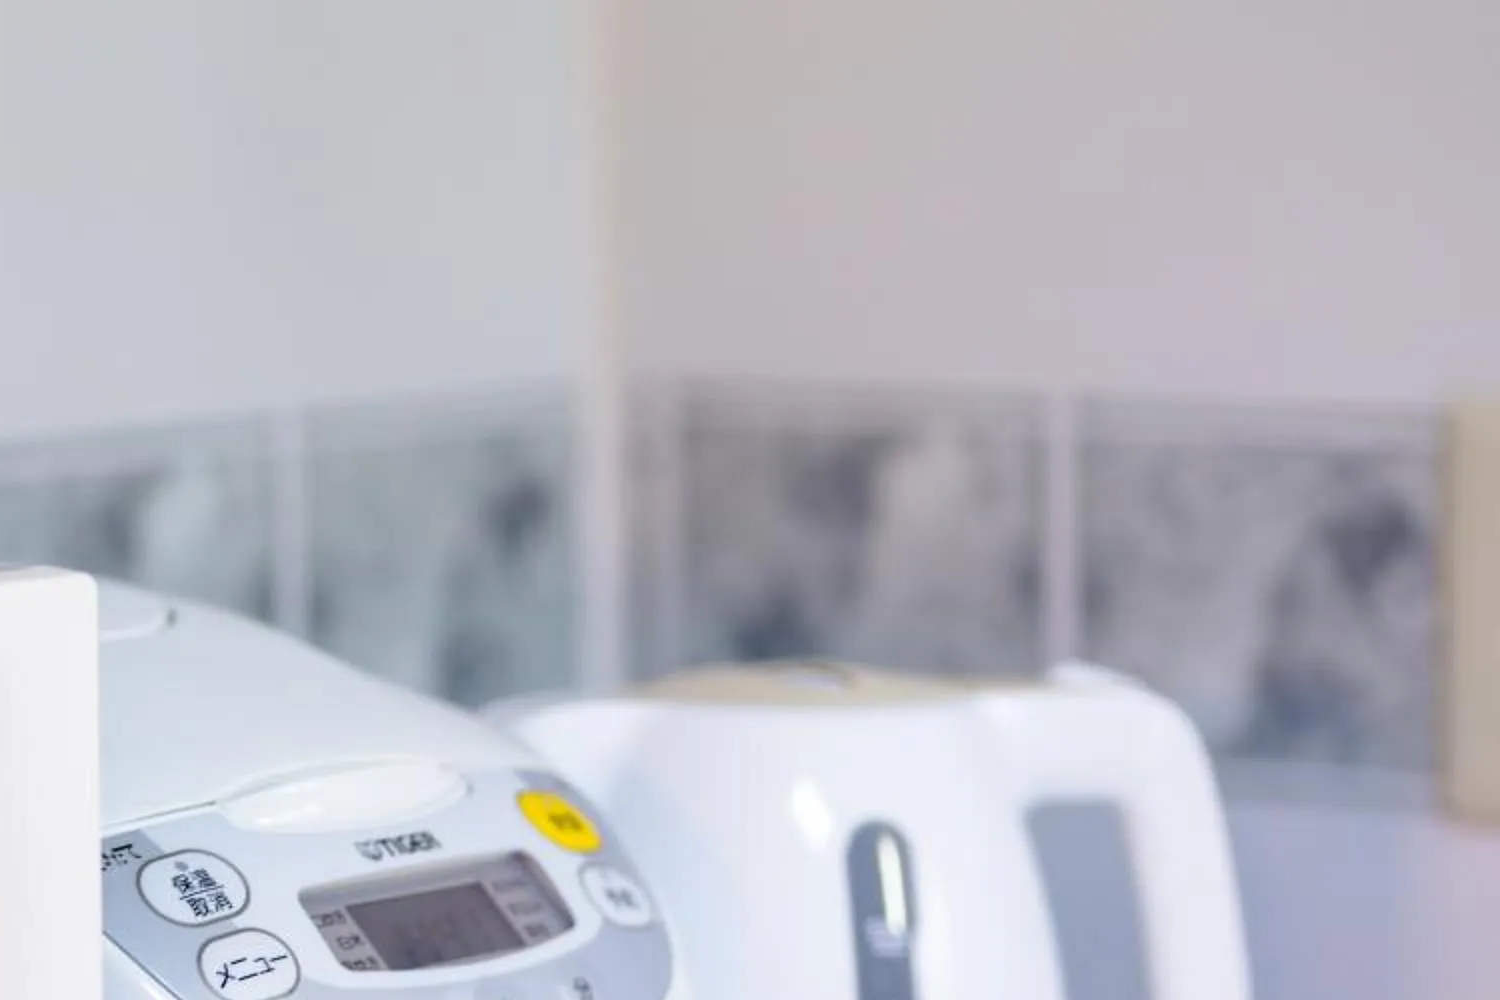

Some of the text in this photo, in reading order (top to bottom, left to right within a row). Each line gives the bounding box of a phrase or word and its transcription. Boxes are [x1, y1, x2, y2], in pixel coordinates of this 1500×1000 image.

[171, 868, 219, 894] 保温
[186, 891, 234, 917] 取消
[215, 954, 288, 989] メニュー
